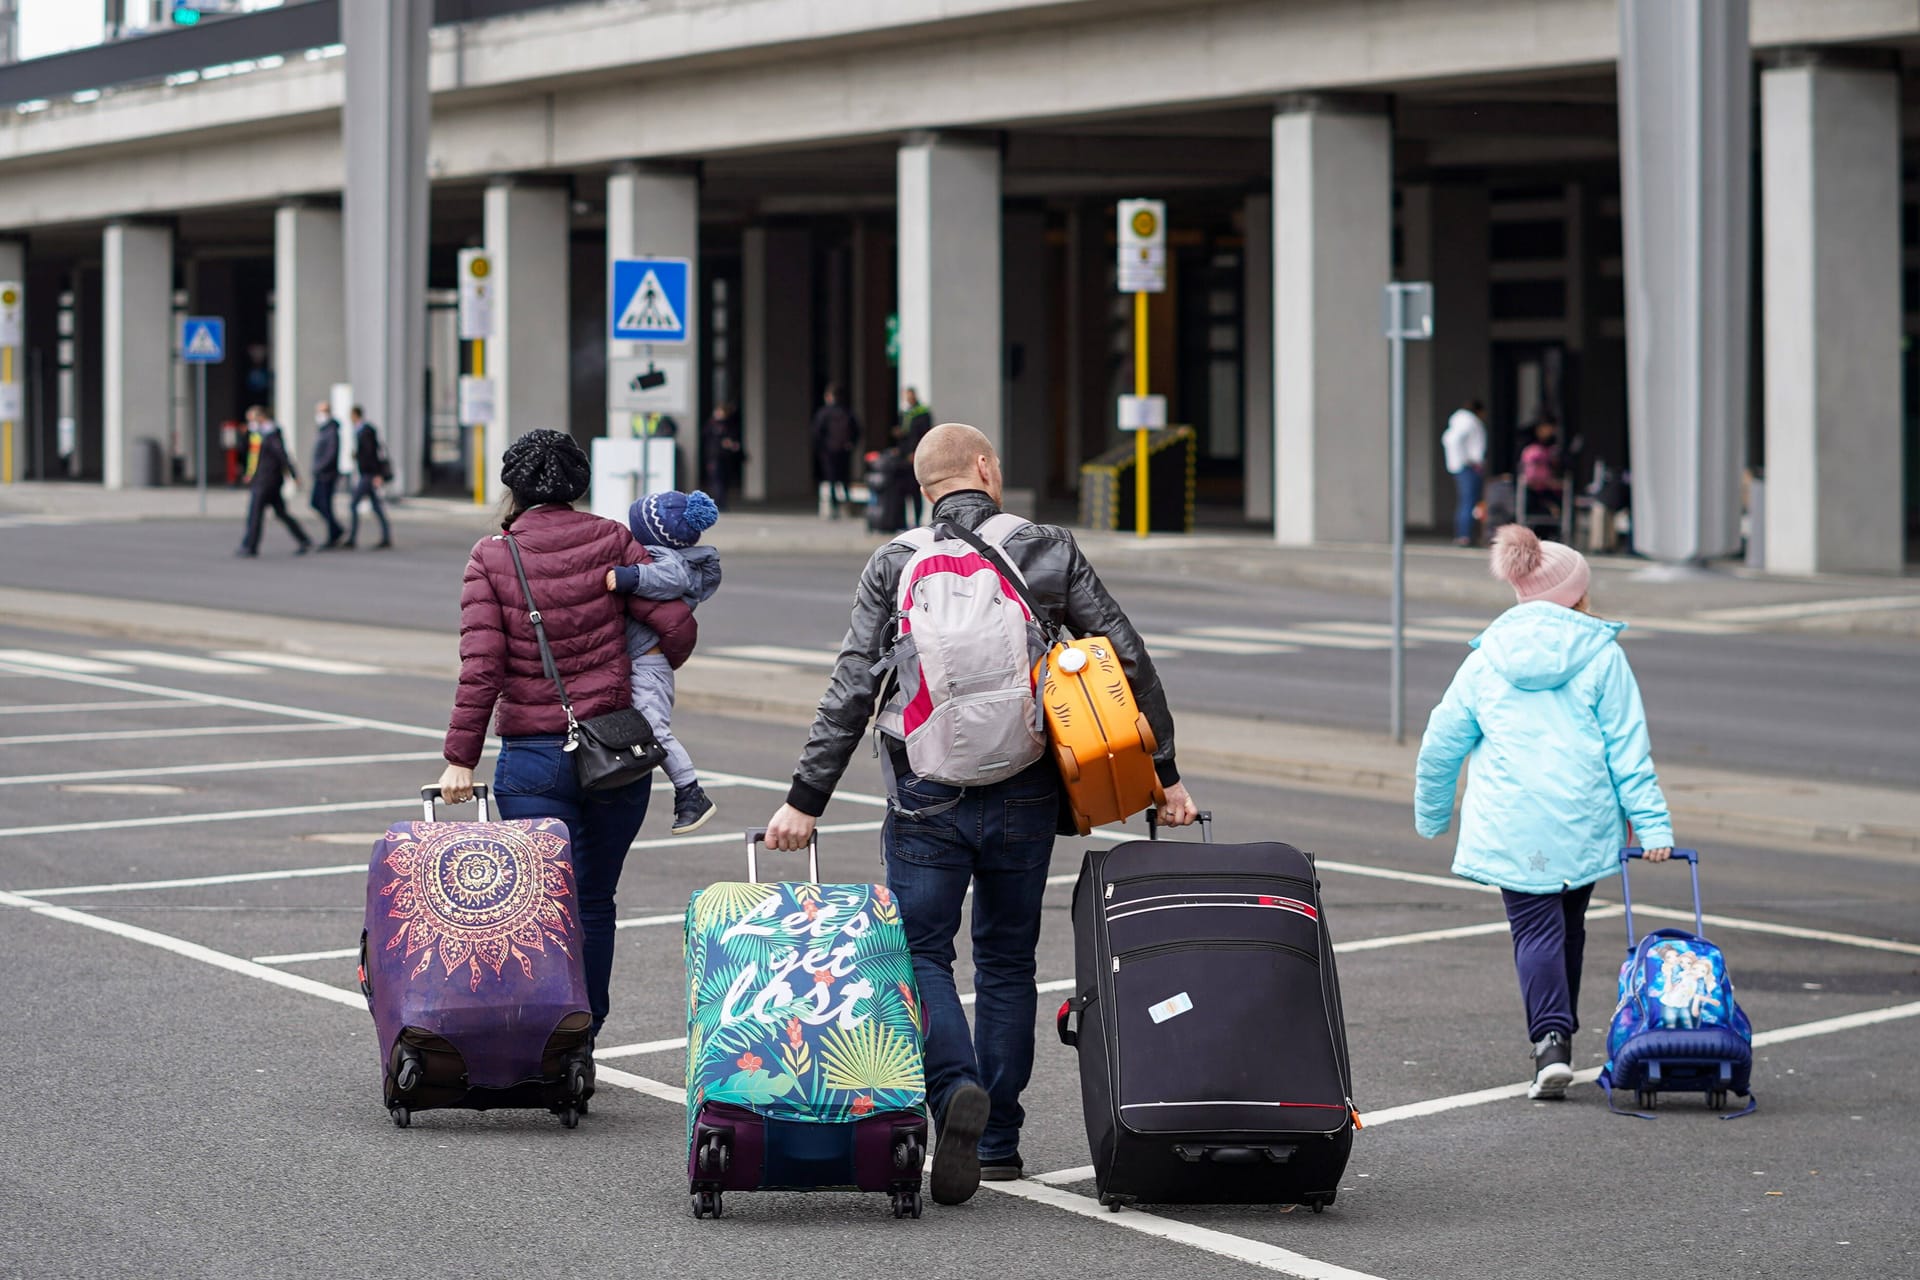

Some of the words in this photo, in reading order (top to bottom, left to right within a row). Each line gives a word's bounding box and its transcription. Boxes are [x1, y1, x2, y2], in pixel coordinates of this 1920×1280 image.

[720, 892, 873, 945] Let's
[769, 942, 857, 979] get
[720, 961, 875, 1030] lost
